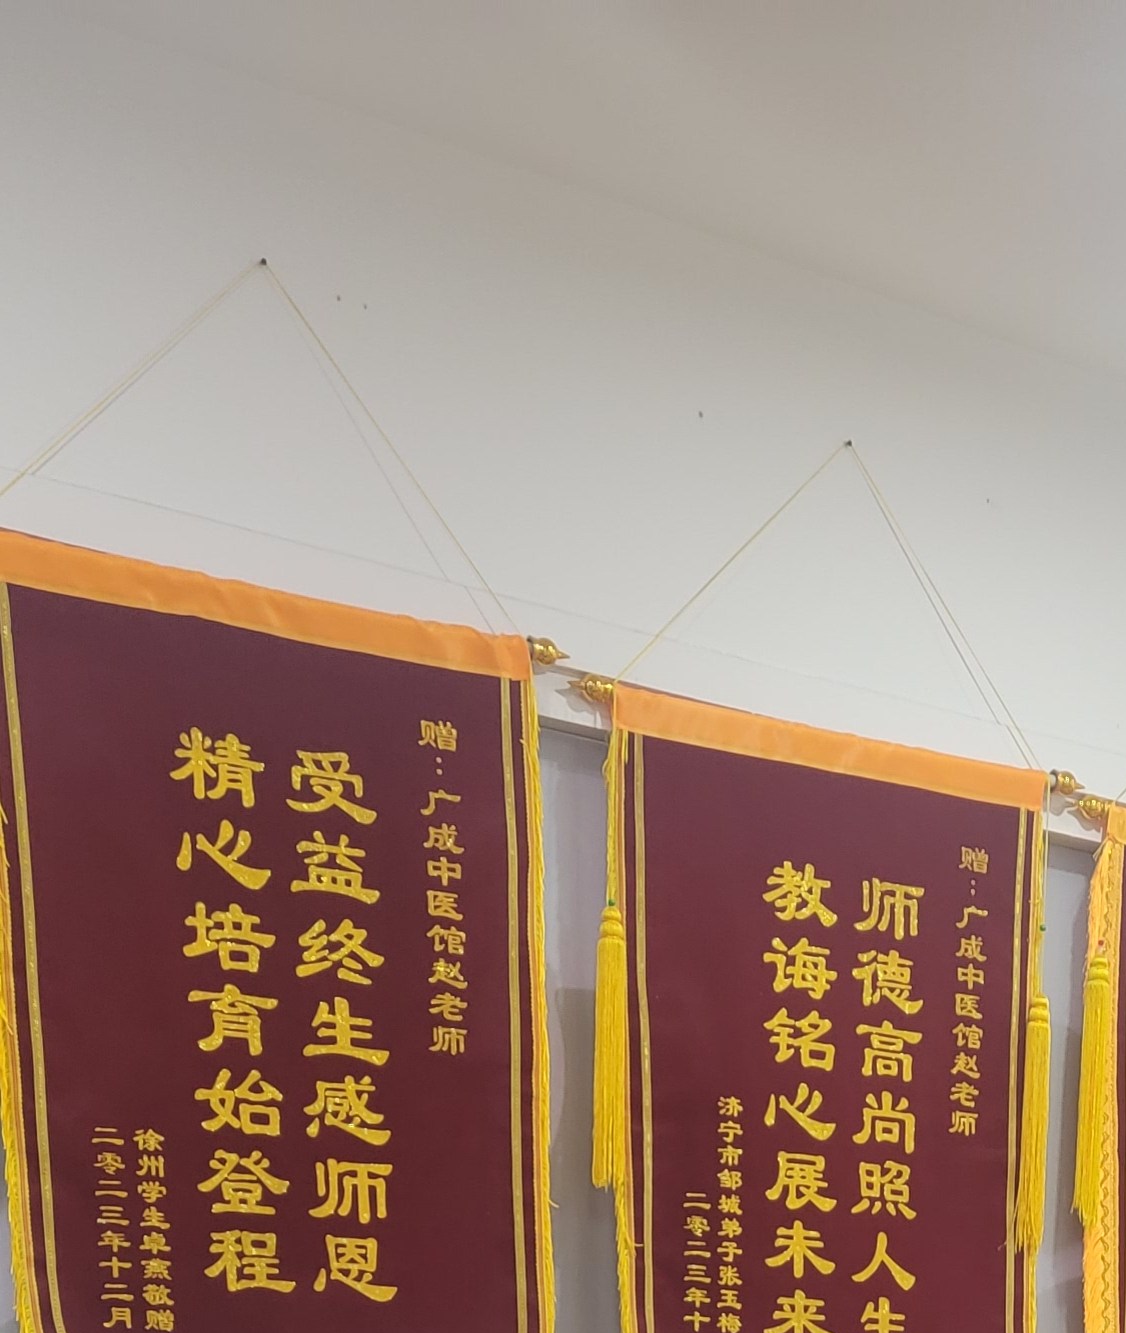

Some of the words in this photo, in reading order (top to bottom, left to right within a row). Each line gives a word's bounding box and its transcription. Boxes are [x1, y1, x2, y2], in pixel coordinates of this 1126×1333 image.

[169, 726, 296, 1295] 精心培育始登程
[286, 749, 398, 1302] 受益终生感师恩
[418, 720, 467, 1055] 赠：广成中医馆赵老师
[91, 1127, 135, 1329] 二零二三年十二月
[132, 1128, 174, 1332] 徐州学生卓燕敬赠
